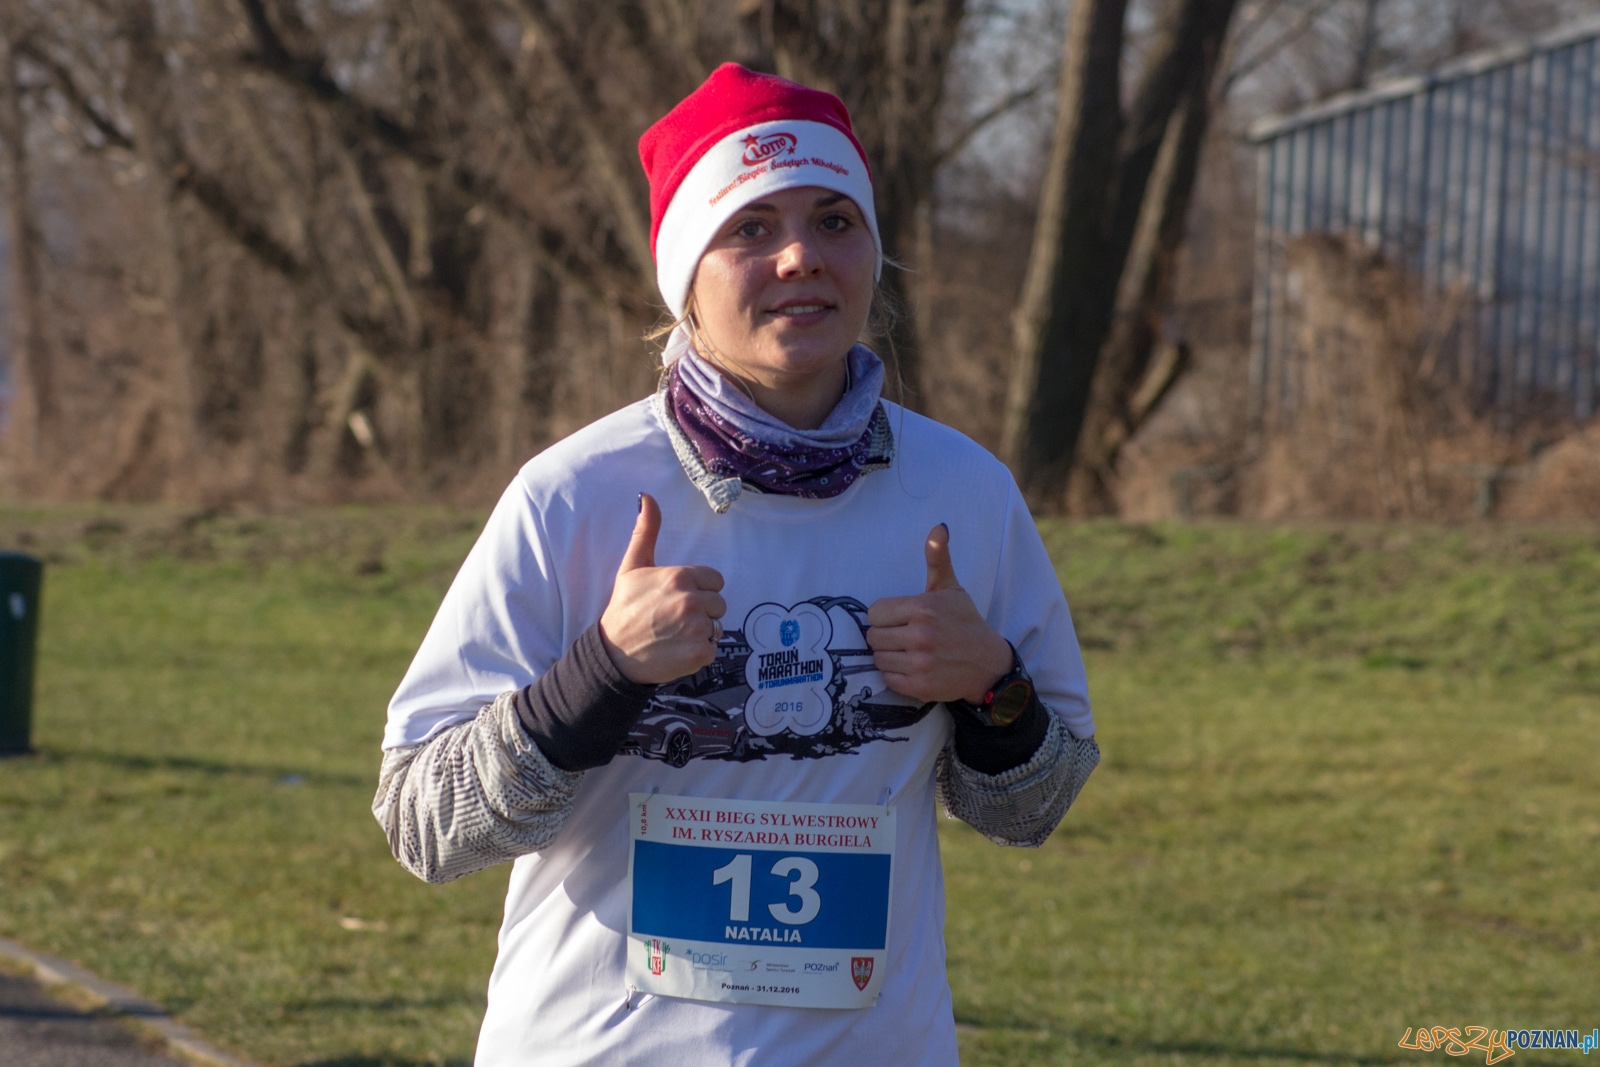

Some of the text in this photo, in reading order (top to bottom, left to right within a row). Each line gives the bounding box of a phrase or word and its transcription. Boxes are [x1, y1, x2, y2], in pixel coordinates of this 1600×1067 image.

[751, 137, 787, 159] LOTTO
[758, 646, 799, 668] TORUŃ
[758, 659, 824, 681] MARATHON
[758, 673, 824, 690] #TORUNMARATHON
[775, 702, 803, 712] 2016
[641, 804, 647, 817] km
[665, 807, 879, 829] XXXII BIEG SYLWESTROWY
[672, 826, 872, 848] IM. RYSZARDA BURGIELA
[713, 854, 821, 925] 13
[725, 925, 802, 943] NATALIA
[652, 939, 661, 954] TK
[652, 957, 661, 974] KF
[692, 952, 728, 966] posir
[721, 982, 749, 992] Poznań
[756, 984, 800, 994] 31.12.2016
